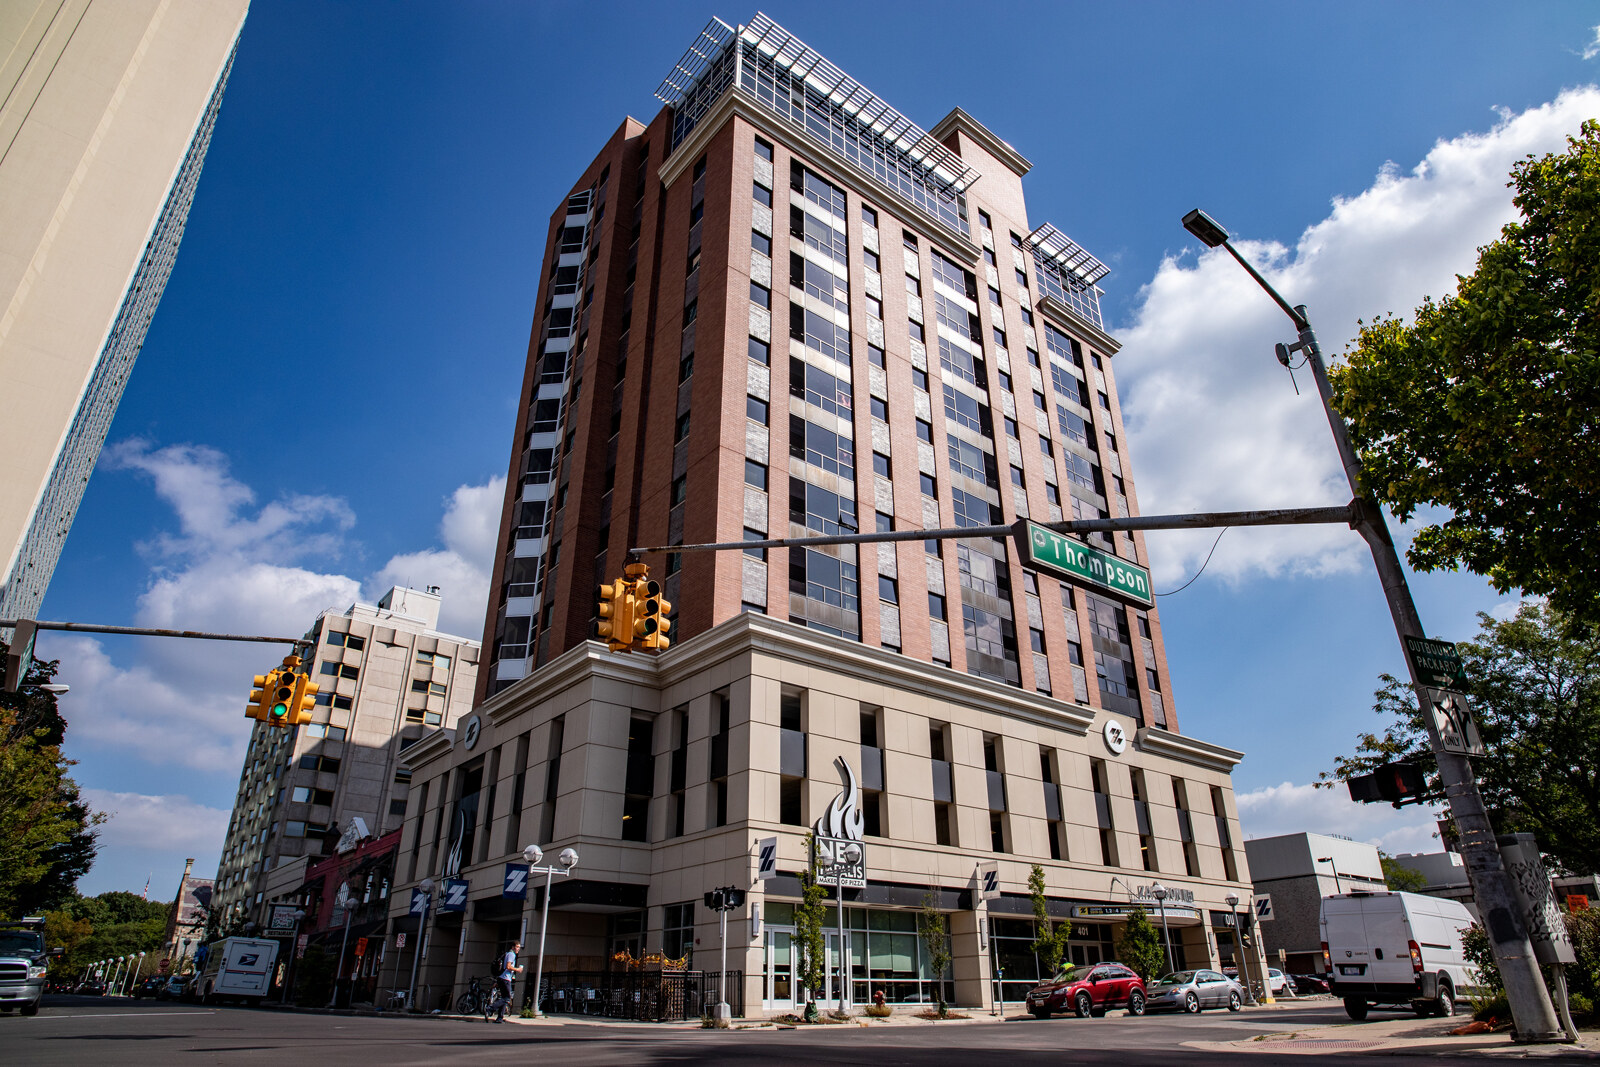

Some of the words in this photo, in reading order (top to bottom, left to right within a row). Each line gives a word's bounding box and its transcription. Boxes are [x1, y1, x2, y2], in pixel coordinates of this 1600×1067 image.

[1050, 535, 1146, 593] Thompson
[1408, 640, 1456, 657] OUTBOUND
[1417, 657, 1456, 672] PACKARD
[1445, 736, 1460, 746] ONLY
[819, 877, 838, 885] MAKER
[849, 879, 864, 887] PIZZA
[1077, 926, 1089, 936] 401
